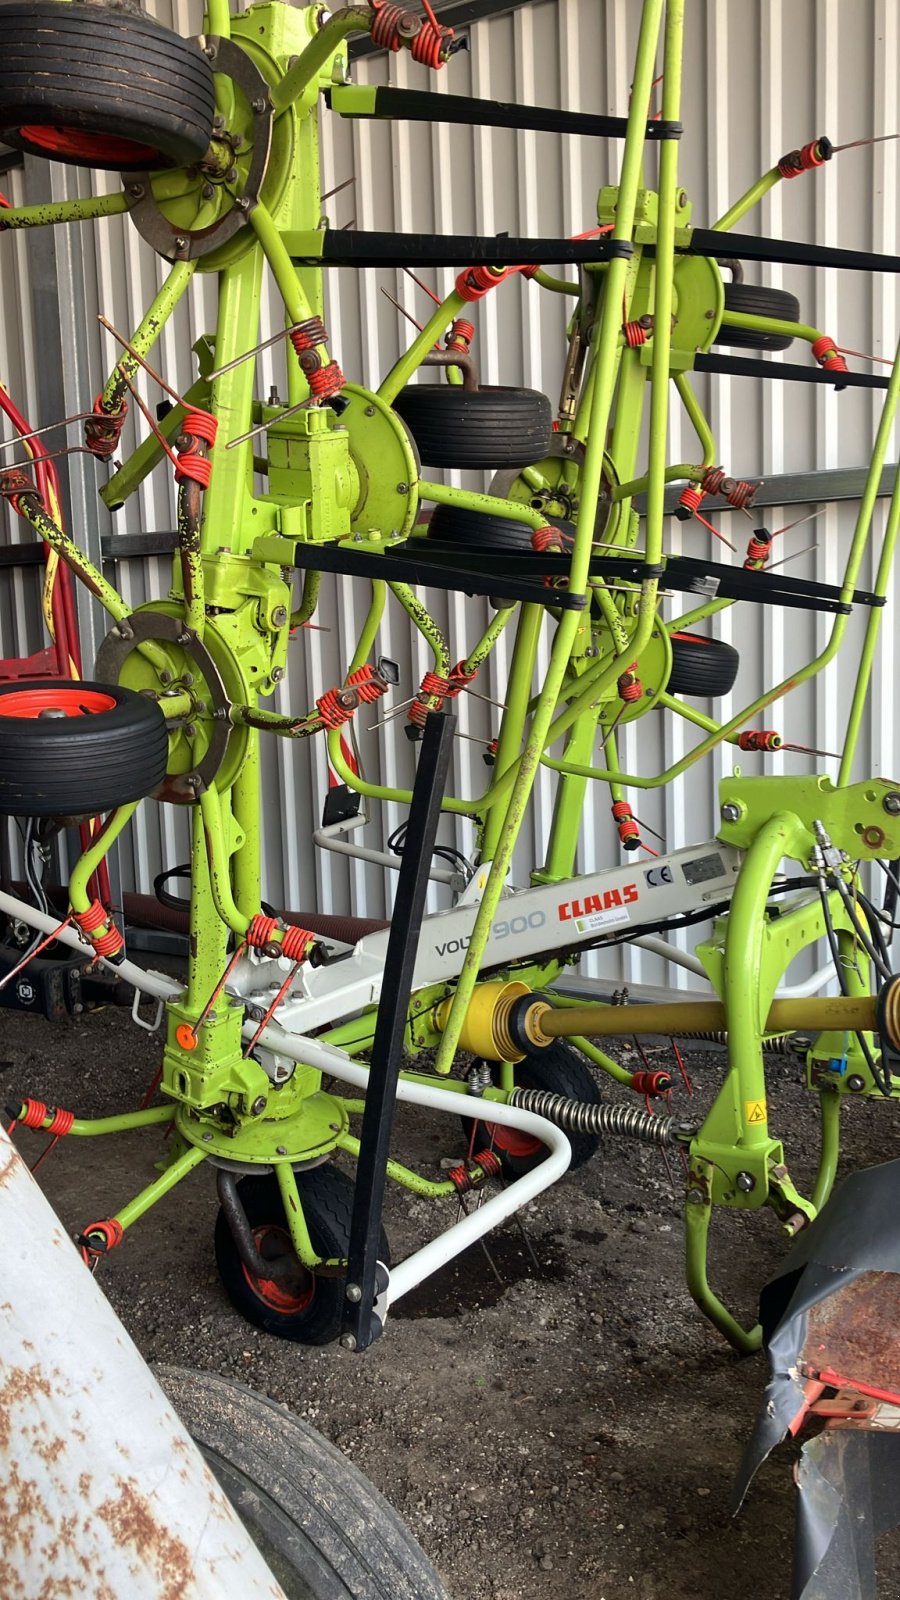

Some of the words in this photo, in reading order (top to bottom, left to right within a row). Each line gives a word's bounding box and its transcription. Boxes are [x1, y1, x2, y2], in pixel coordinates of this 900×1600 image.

[558, 883, 639, 922] CLAAS
[434, 934, 489, 957] VOLT
[492, 910, 546, 940] 900
